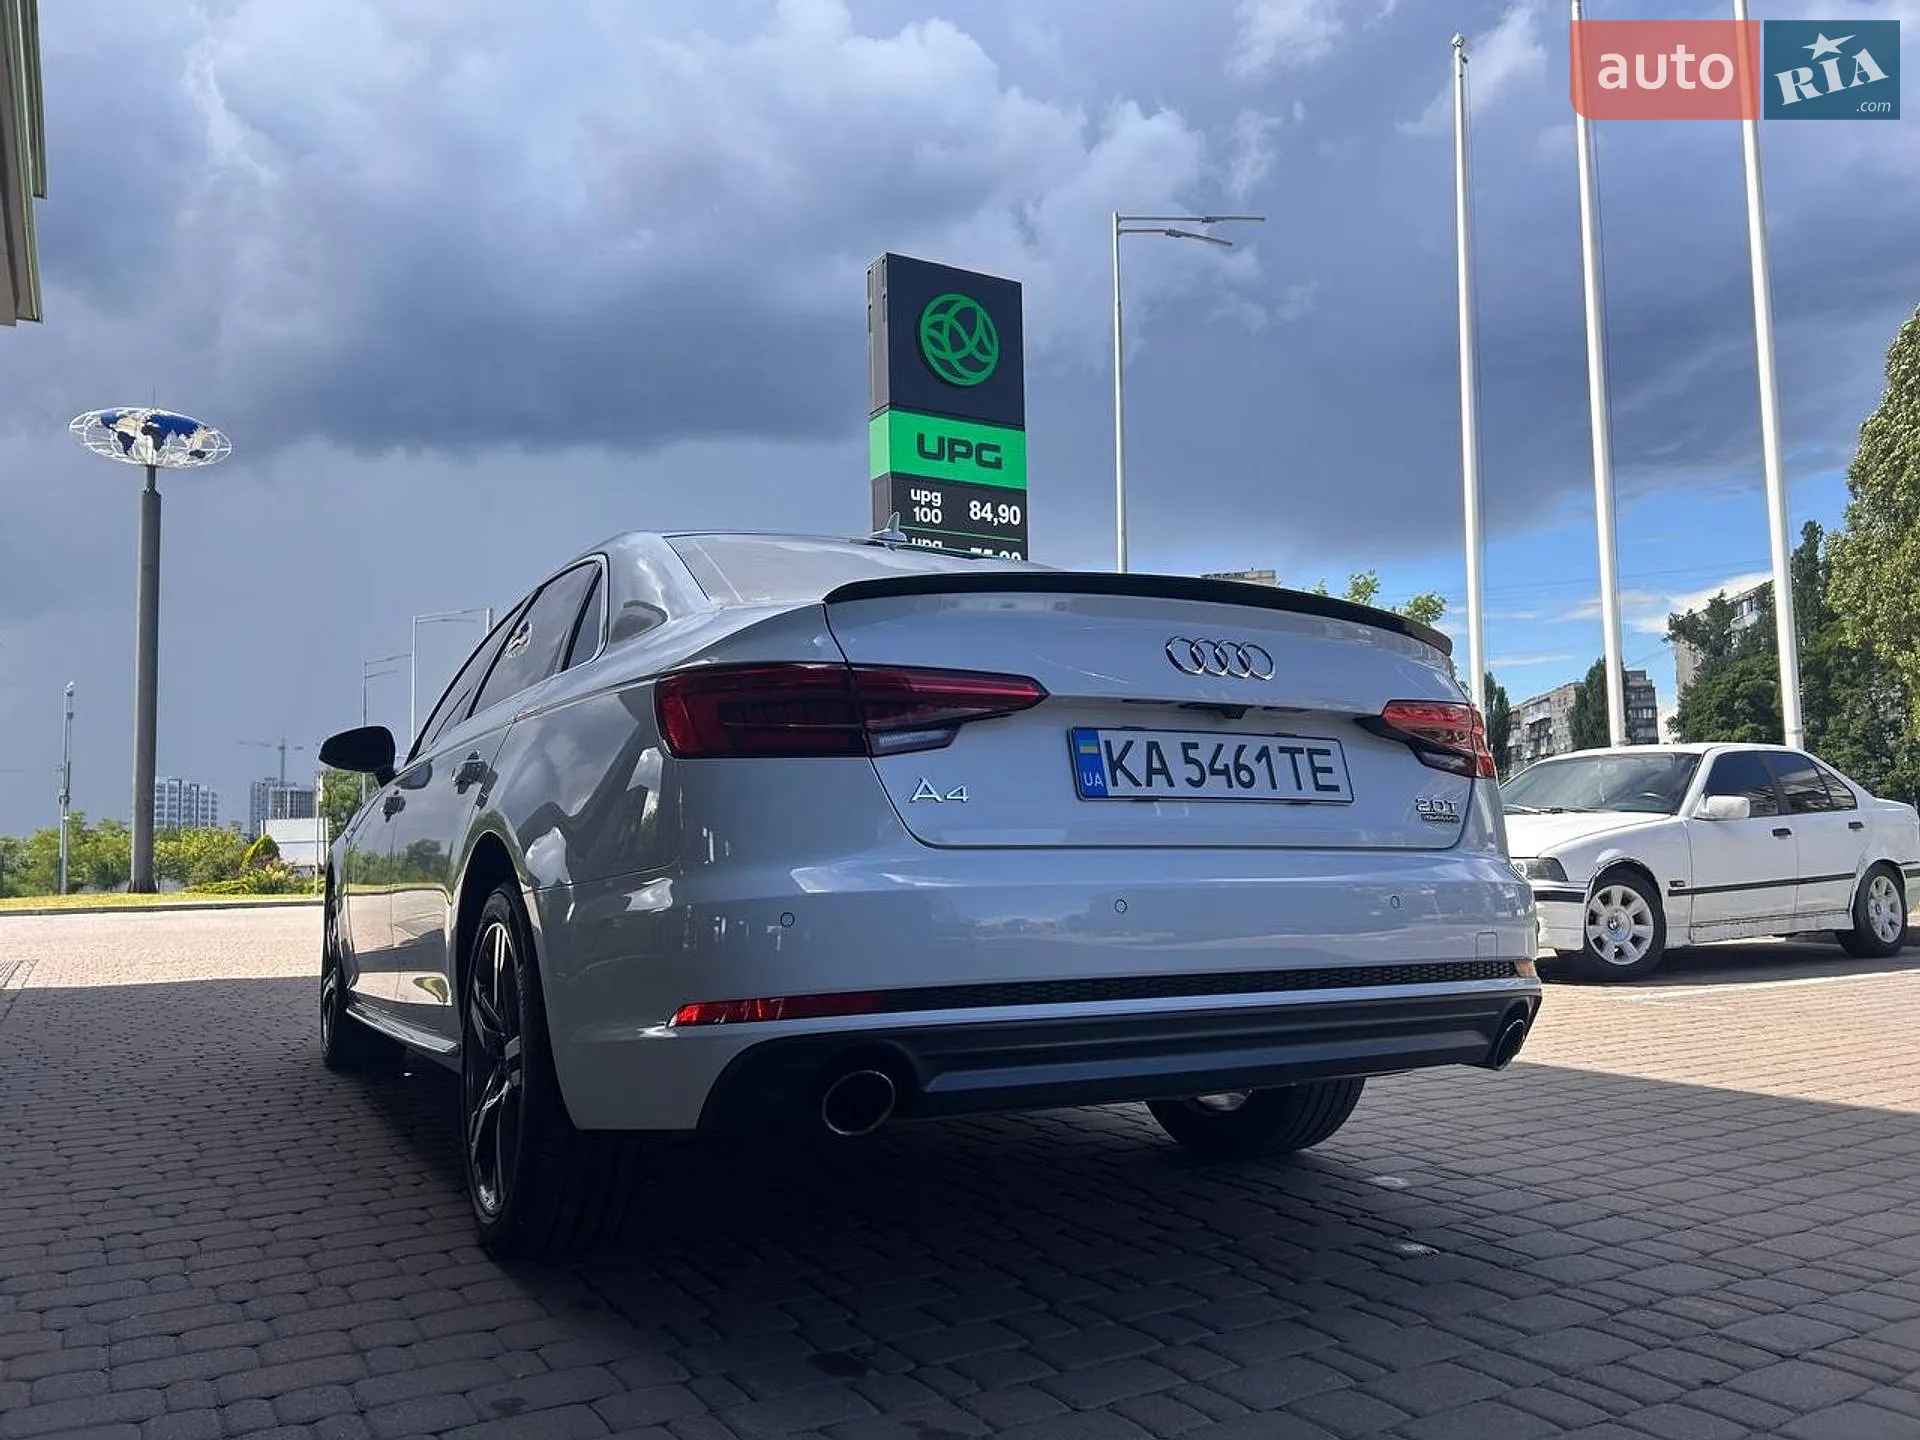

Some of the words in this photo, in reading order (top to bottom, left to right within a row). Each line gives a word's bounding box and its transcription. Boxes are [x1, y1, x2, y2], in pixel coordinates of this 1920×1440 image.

[916, 432, 1003, 470] UPG
[910, 488, 942, 507] upg
[913, 507, 942, 524] 100
[969, 500, 1021, 526] 84,90
[909, 778, 969, 803] A4
[1083, 772, 1105, 788] UA
